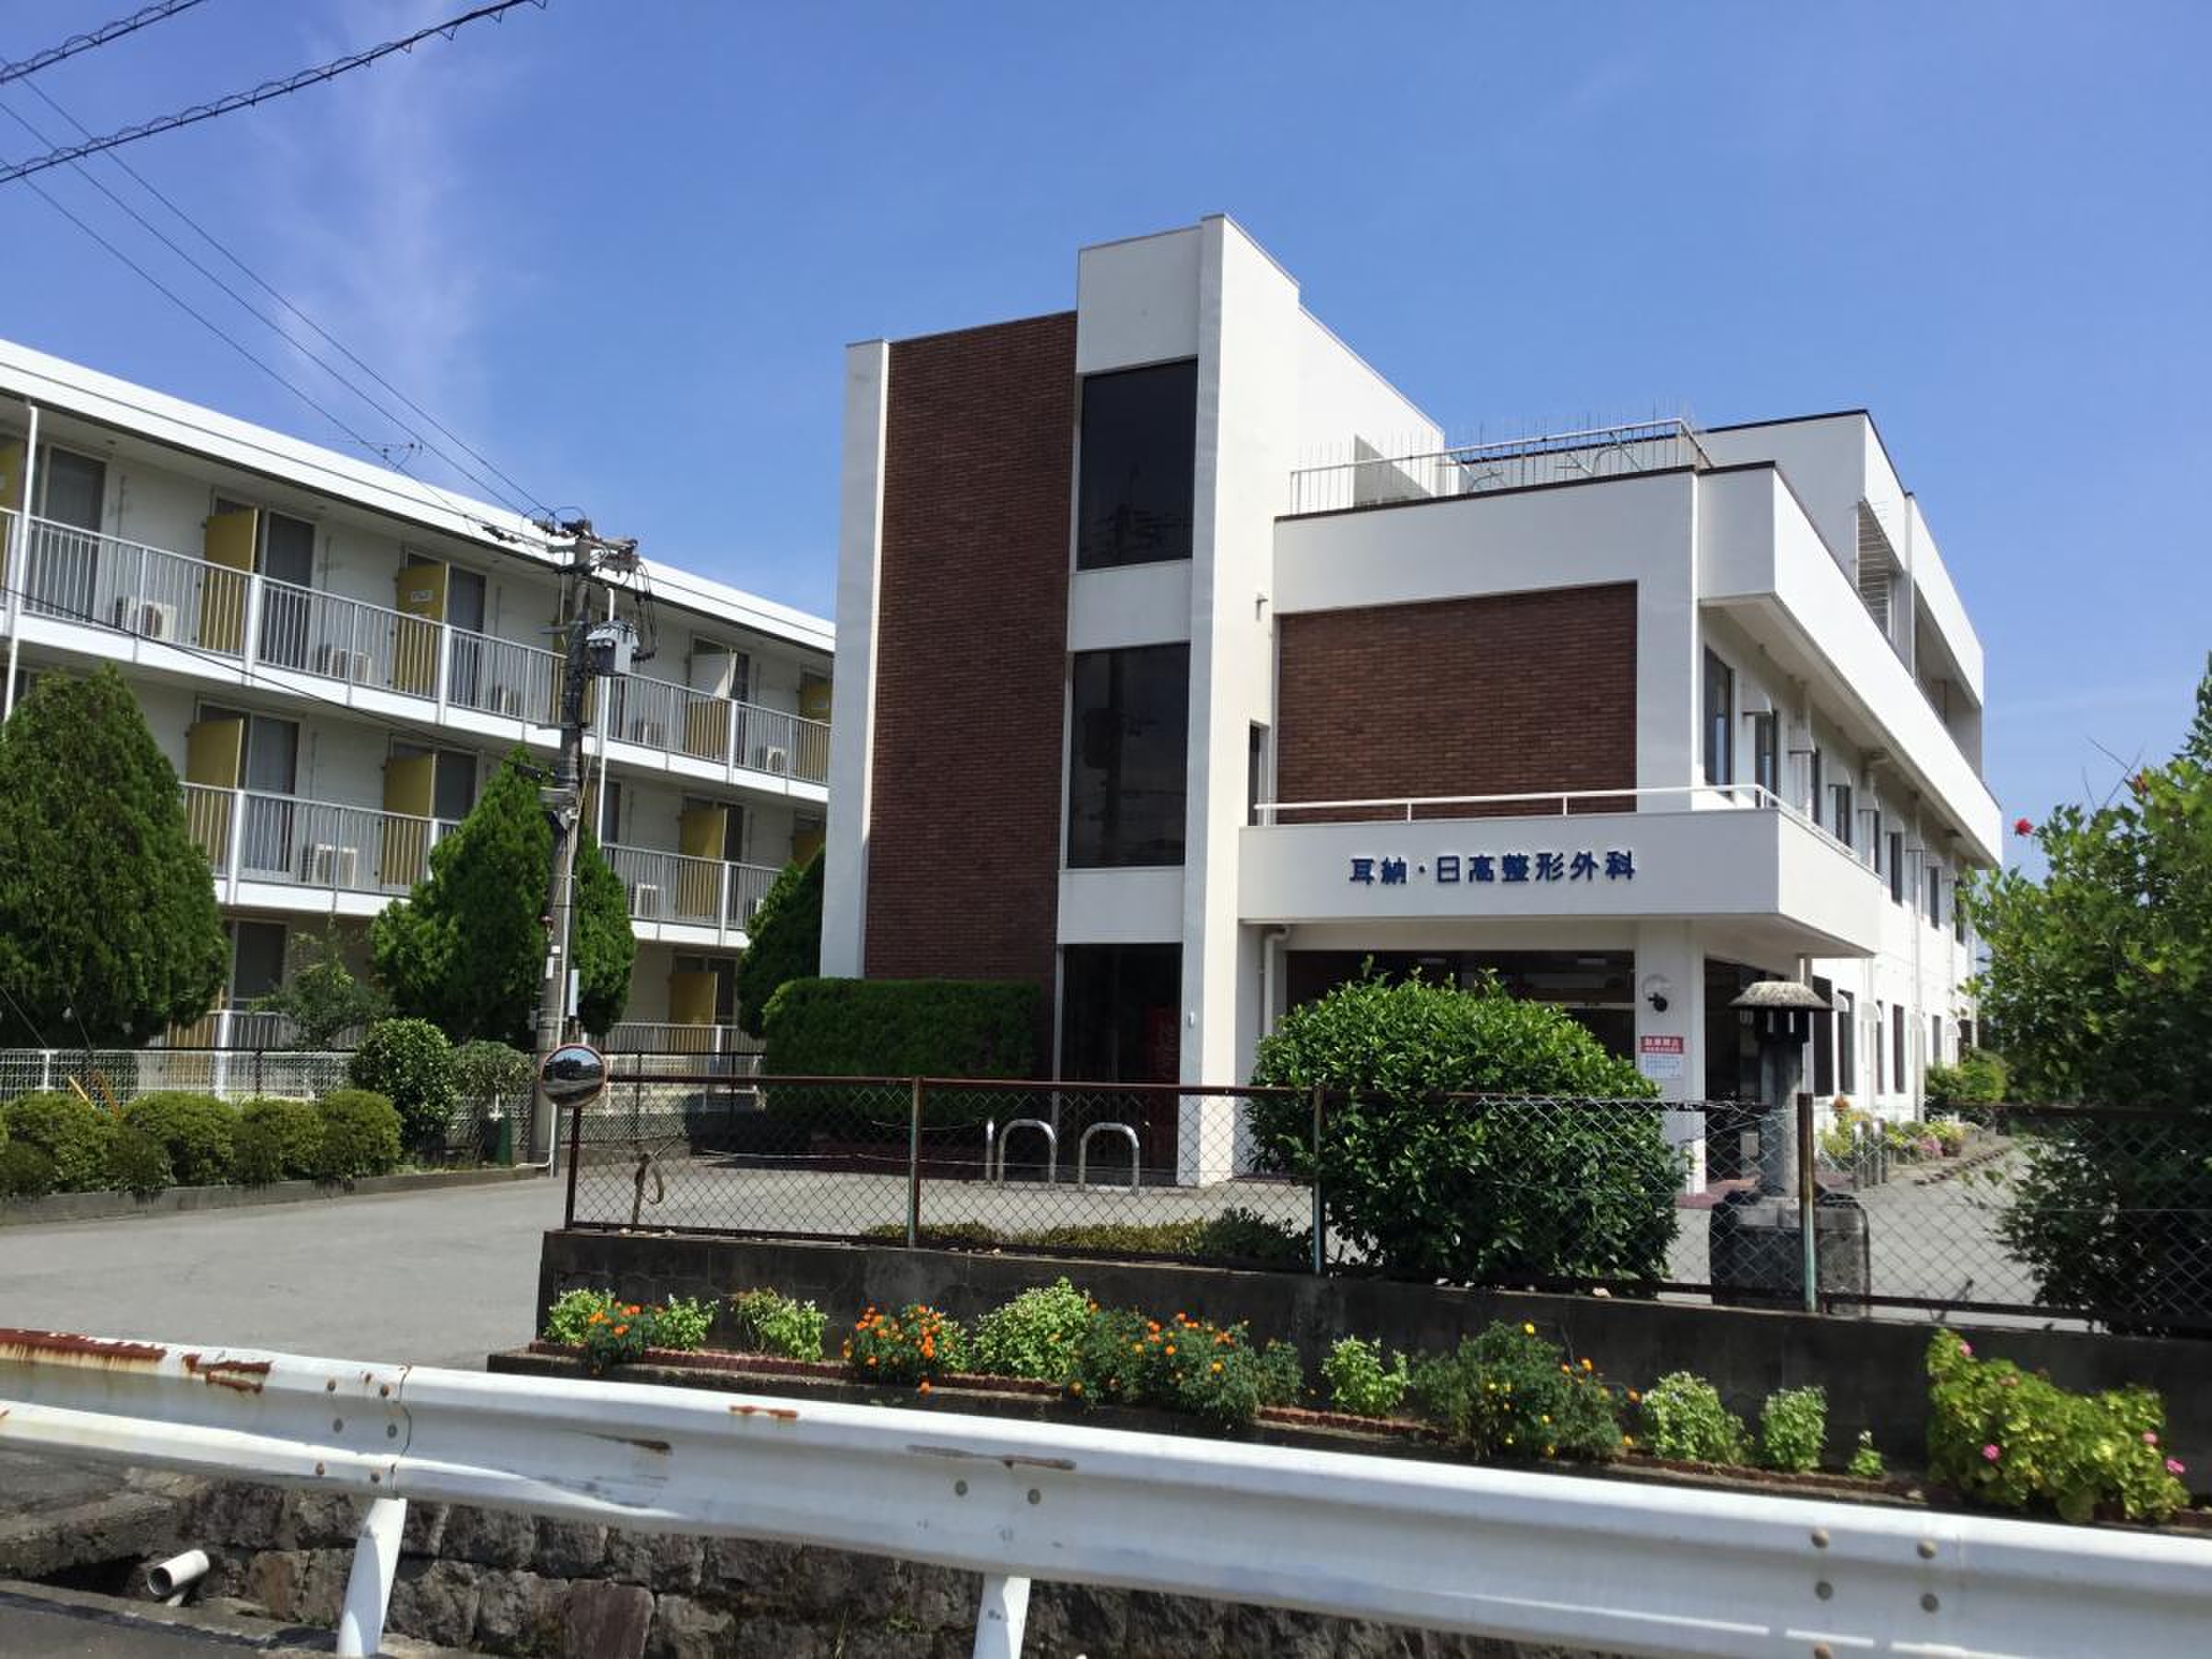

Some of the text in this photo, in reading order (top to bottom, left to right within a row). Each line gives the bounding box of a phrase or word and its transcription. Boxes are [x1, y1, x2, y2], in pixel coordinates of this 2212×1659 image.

[1349, 850, 1635, 884] 耳納・日高整形外科
